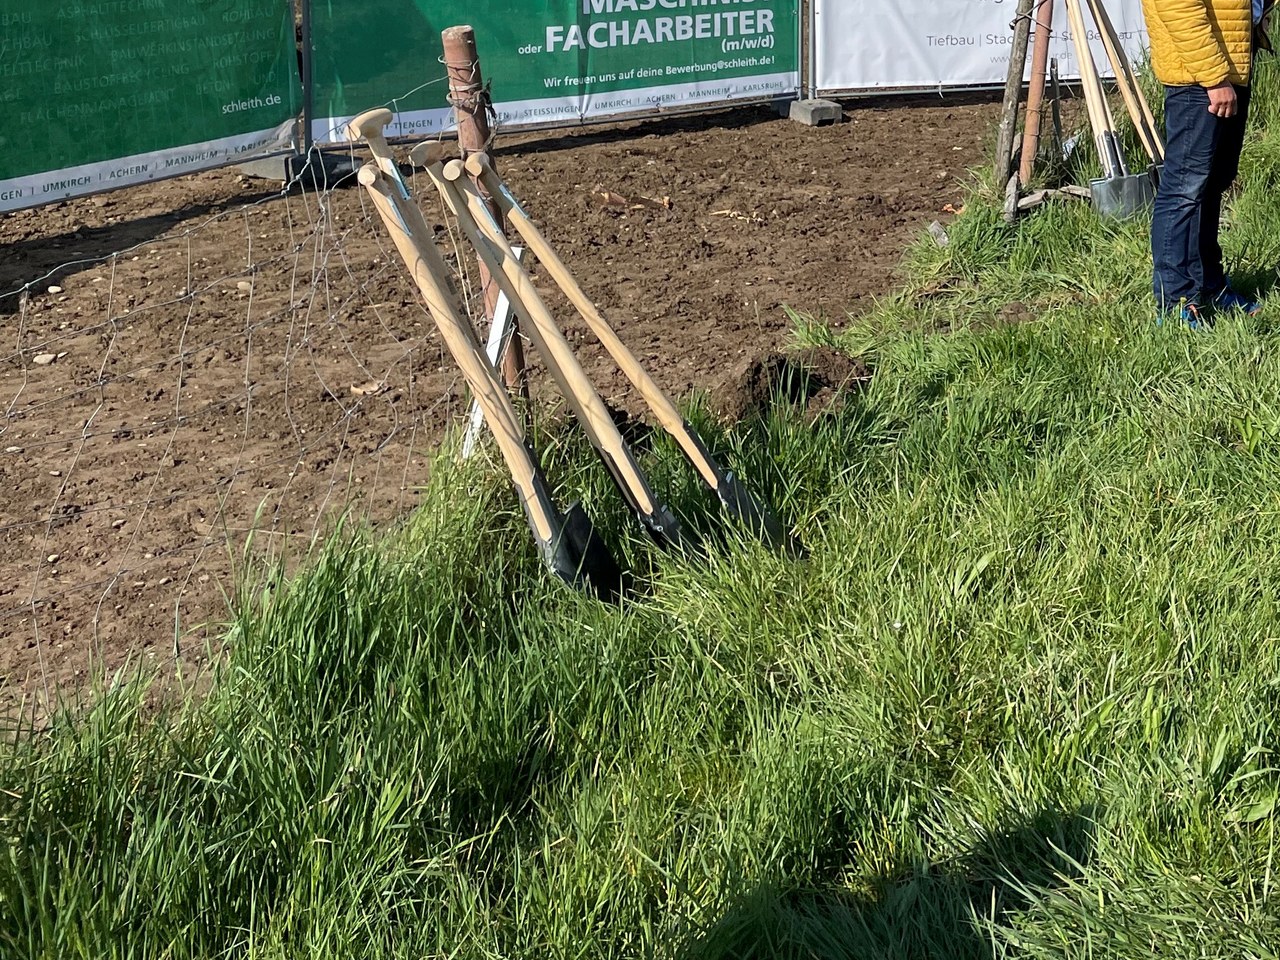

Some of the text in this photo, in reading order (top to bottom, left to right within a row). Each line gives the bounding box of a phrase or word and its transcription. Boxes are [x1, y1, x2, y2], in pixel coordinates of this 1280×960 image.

[518, 9, 775, 55] oder FACHARBEITER
[926, 34, 975, 47] Tiefbau
[721, 35, 775, 53] (m/w/d)
[543, 76, 562, 88] Wir
[564, 73, 597, 86] freuen
[599, 74, 616, 84] uns
[618, 70, 636, 83] auf
[637, 69, 663, 80] deine
[222, 94, 282, 115] schleith.de
[524, 105, 581, 117] STEISSLINGEN
[594, 97, 632, 109] UMKIRCH
[645, 93, 676, 104] ACHERN
[688, 87, 731, 98] MANNHEIM
[742, 81, 784, 92] KARLSRUHE
[42, 175, 91, 193] UMKIRCH
[109, 164, 148, 179] ACHERN
[165, 150, 218, 168] MANNHEIM
